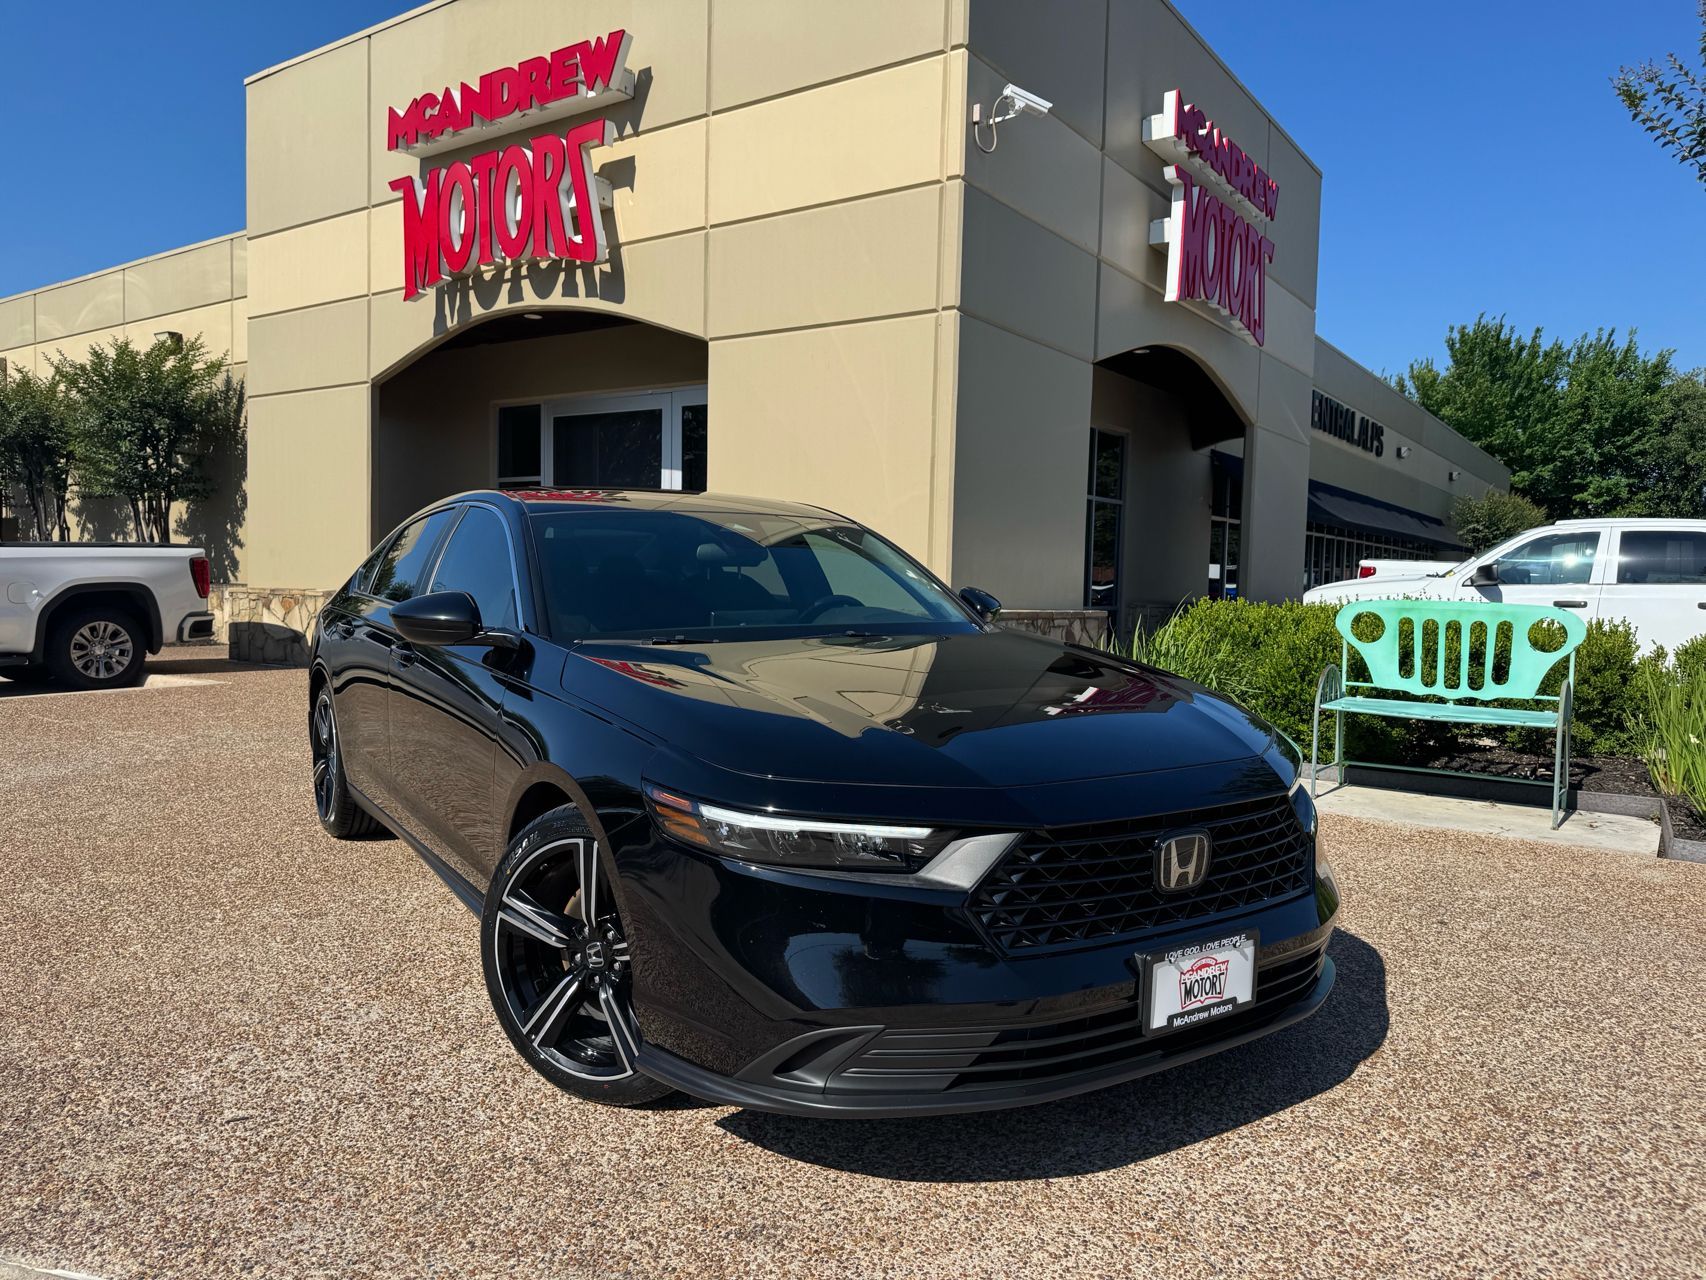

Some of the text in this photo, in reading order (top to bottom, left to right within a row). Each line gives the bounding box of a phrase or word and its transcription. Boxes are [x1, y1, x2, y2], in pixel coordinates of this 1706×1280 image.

[388, 117, 606, 302] MOTORS
[1174, 163, 1276, 347] MOTORS
[1165, 949, 1183, 961] LOVE
[1184, 945, 1201, 956] GOD.
[1202, 940, 1220, 952] LOVE
[1181, 972, 1225, 1005] MOTORS
[1173, 1003, 1233, 1028] McAndrew Motors
